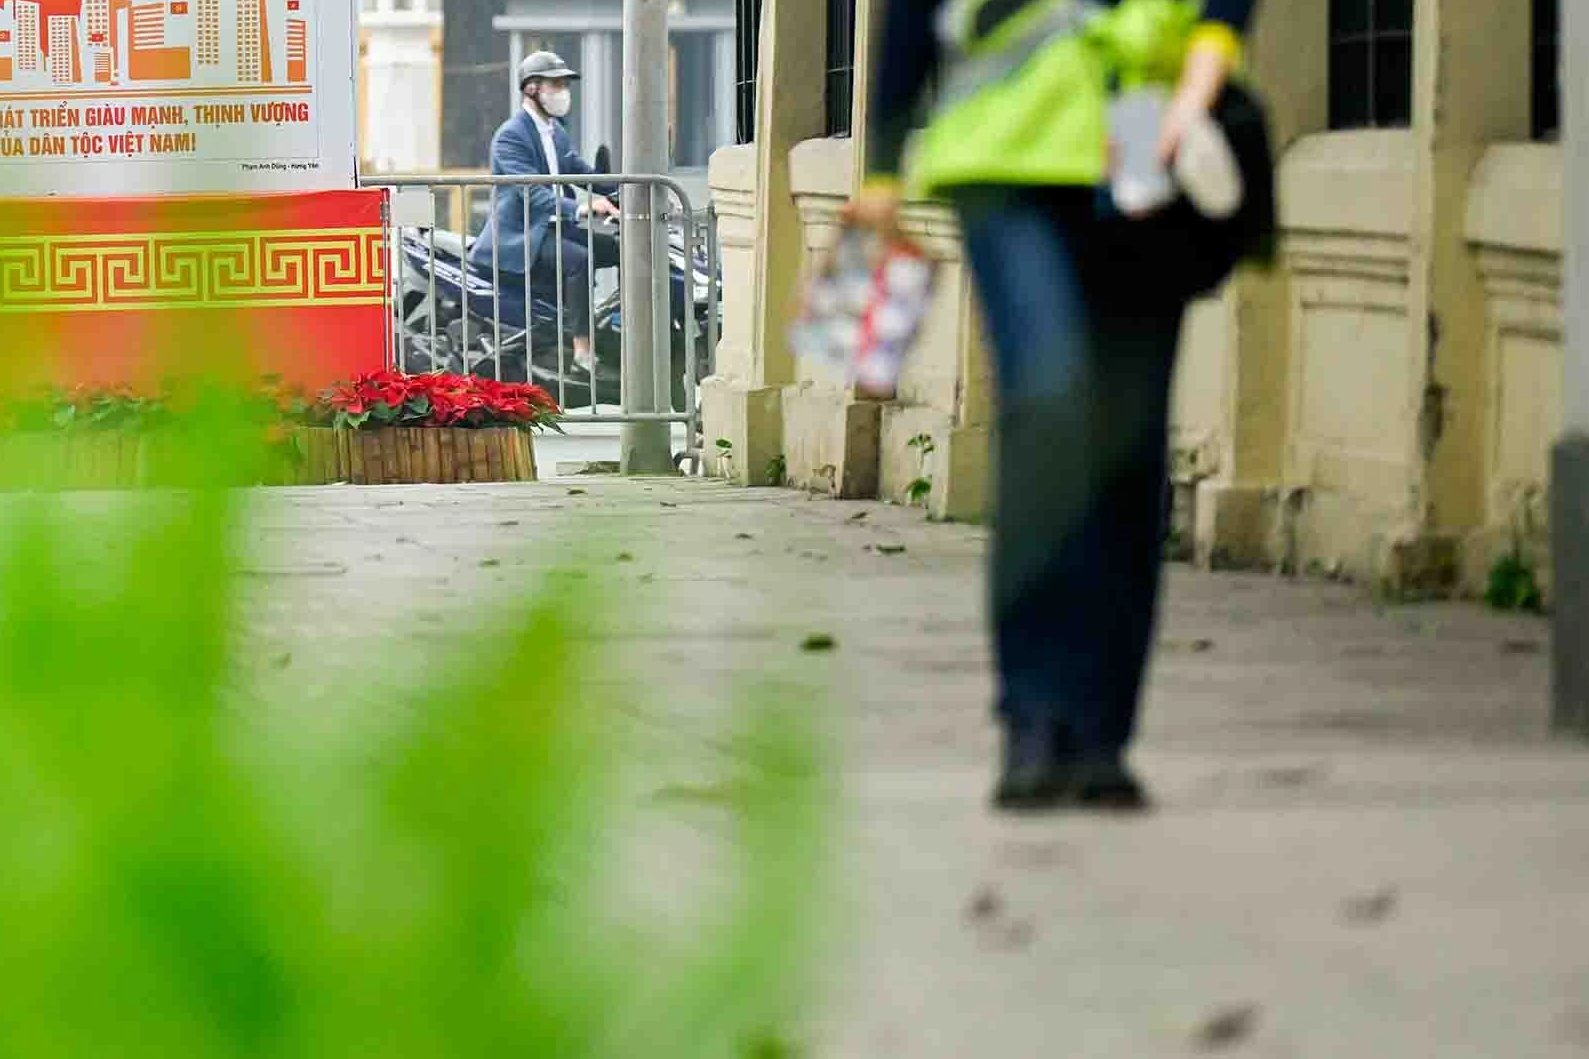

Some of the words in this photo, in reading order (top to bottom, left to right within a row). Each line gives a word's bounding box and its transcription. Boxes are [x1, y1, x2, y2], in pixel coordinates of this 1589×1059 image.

[30, 101, 80, 128] TRIỂN
[85, 103, 125, 126] GIÀU
[131, 106, 188, 129] MẠNH,
[193, 104, 245, 128] THỊNH
[250, 101, 309, 126] VƯỢNG
[28, 132, 66, 155] DÂN
[70, 132, 102, 158] TỘC
[107, 131, 144, 157] VIỆT
[149, 132, 196, 152] NAM!
